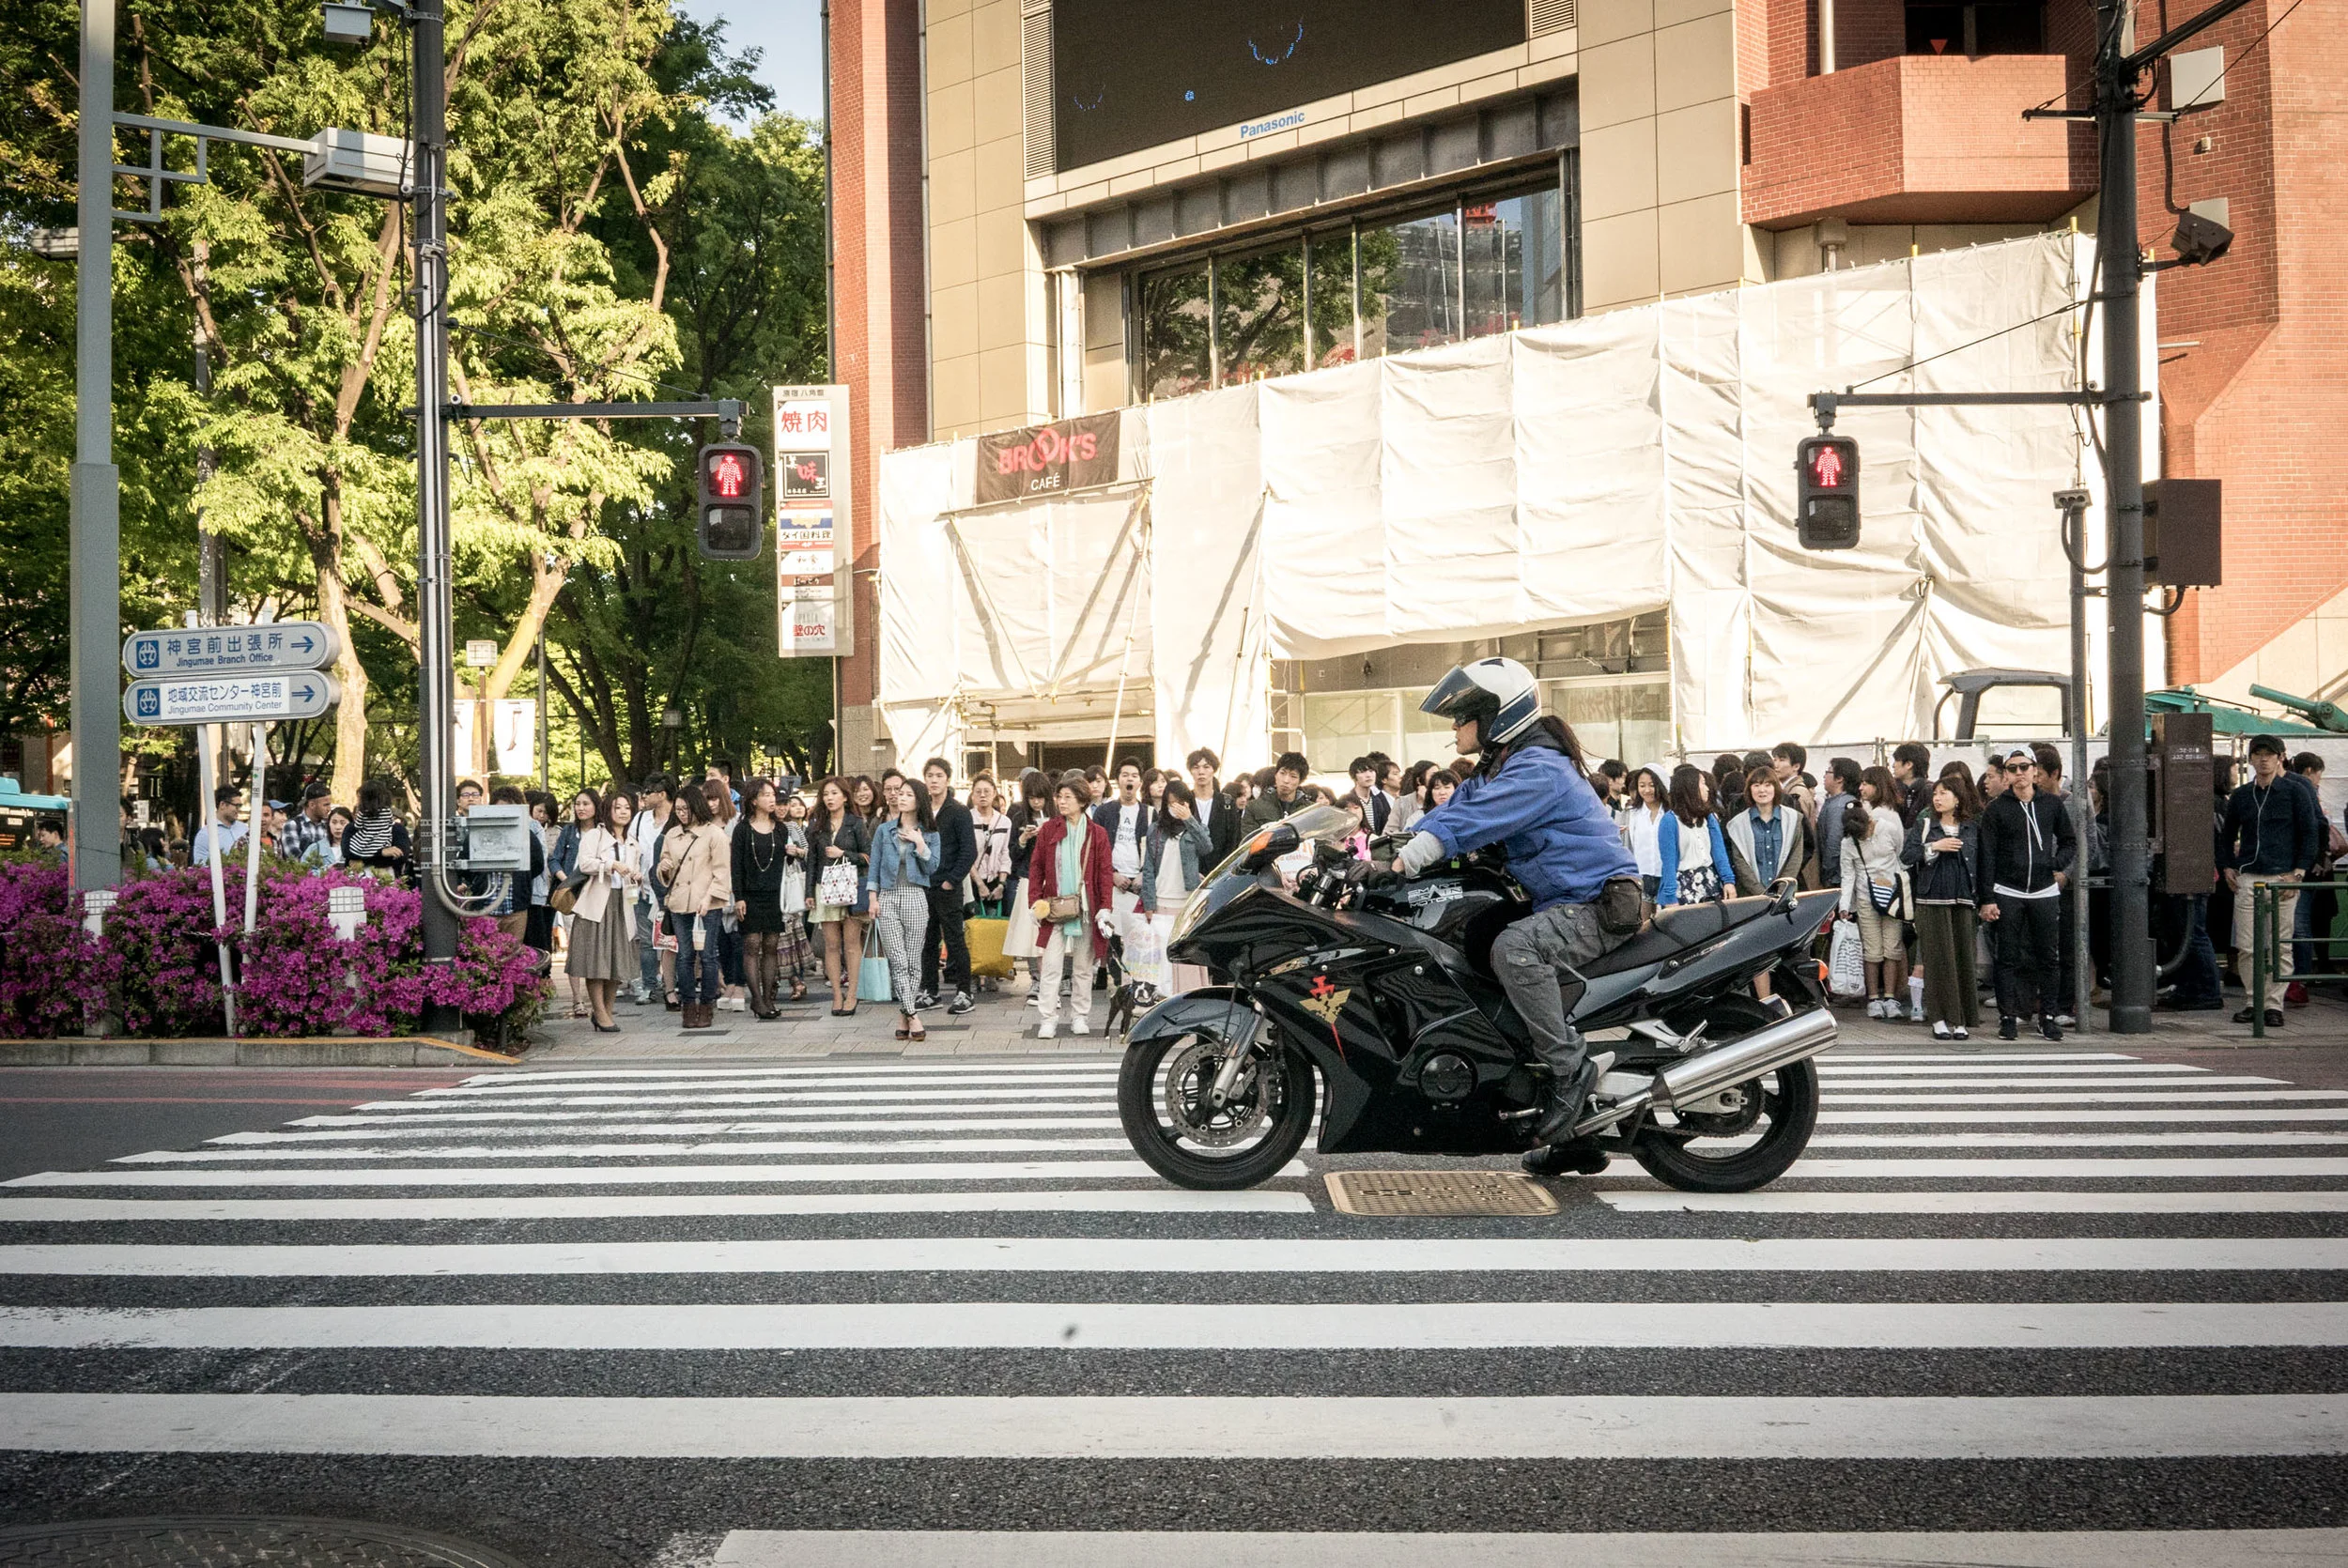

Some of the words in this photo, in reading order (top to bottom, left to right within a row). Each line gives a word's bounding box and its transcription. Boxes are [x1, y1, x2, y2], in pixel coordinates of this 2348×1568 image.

[1240, 111, 1305, 138] Panasonic
[780, 410, 827, 433] 焼肉
[1030, 472, 1060, 491] CAFÉ
[793, 624, 826, 637] 壁の穴
[167, 633, 283, 656] 神宮前出張所
[177, 657, 214, 668] Jingumae
[218, 654, 246, 665] Branch
[249, 653, 273, 663] Office
[167, 683, 282, 703] 地域交流センター神宮前
[168, 705, 206, 715] Jingumae
[208, 700, 253, 713] Community
[255, 699, 282, 710] Center
